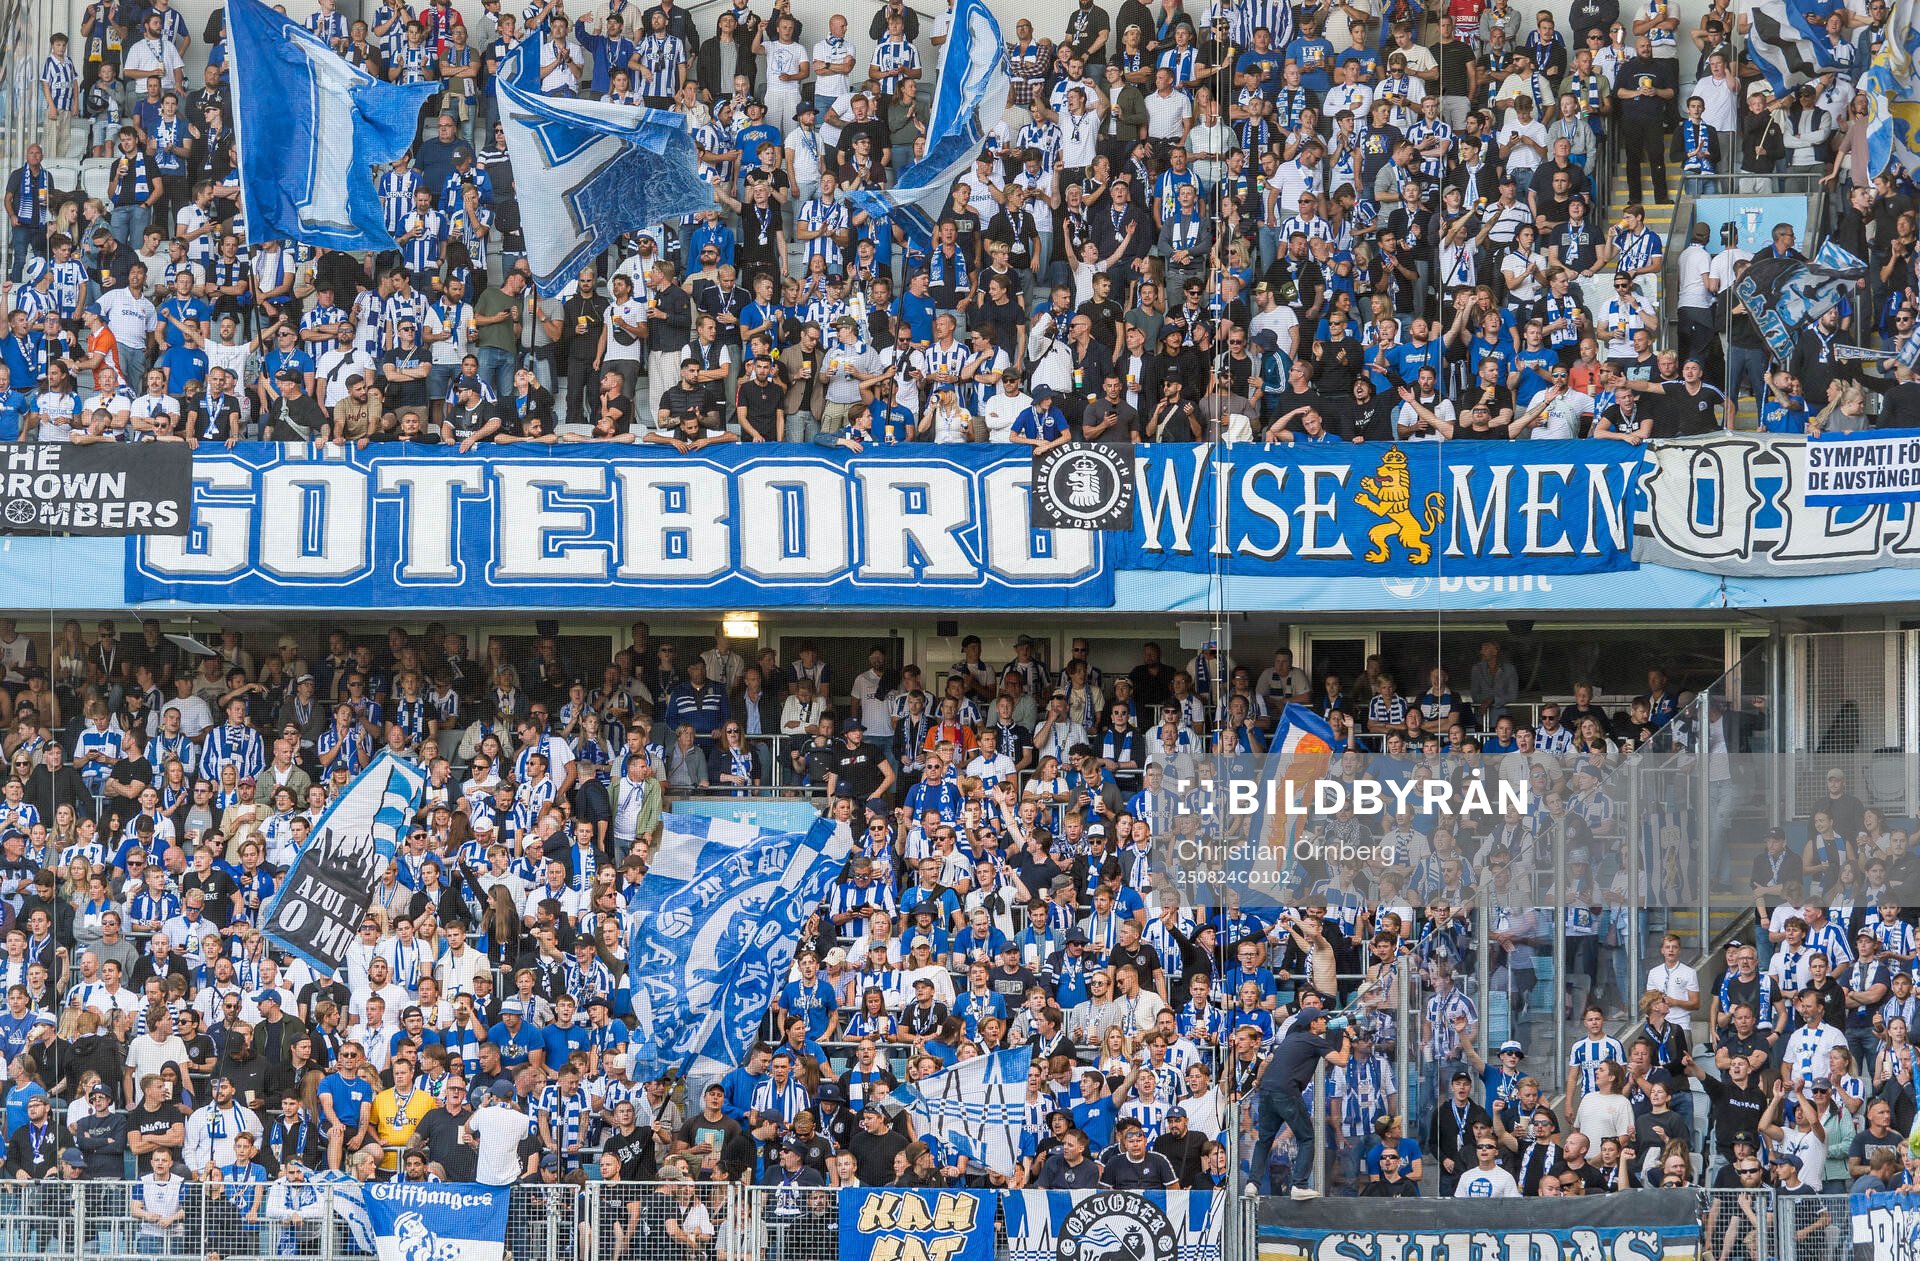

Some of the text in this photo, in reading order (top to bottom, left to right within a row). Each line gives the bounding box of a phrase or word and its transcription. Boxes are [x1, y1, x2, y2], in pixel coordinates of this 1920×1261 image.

[386, 191, 412, 199] SERNEKE
[0, 445, 61, 471] HE
[1809, 446, 1893, 468] SYMPATI
[0, 472, 126, 499] ROWN
[1090, 442, 1130, 477] YOUTH
[1110, 483, 1132, 519] FIRM
[1808, 473, 1829, 491] DE
[1135, 443, 1638, 561] WISE MEN
[295, 874, 347, 919] AZUL
[278, 899, 308, 932] O
[370, 1183, 493, 1211] Cliffhangers
[1066, 1193, 1166, 1236] OKTOBER
